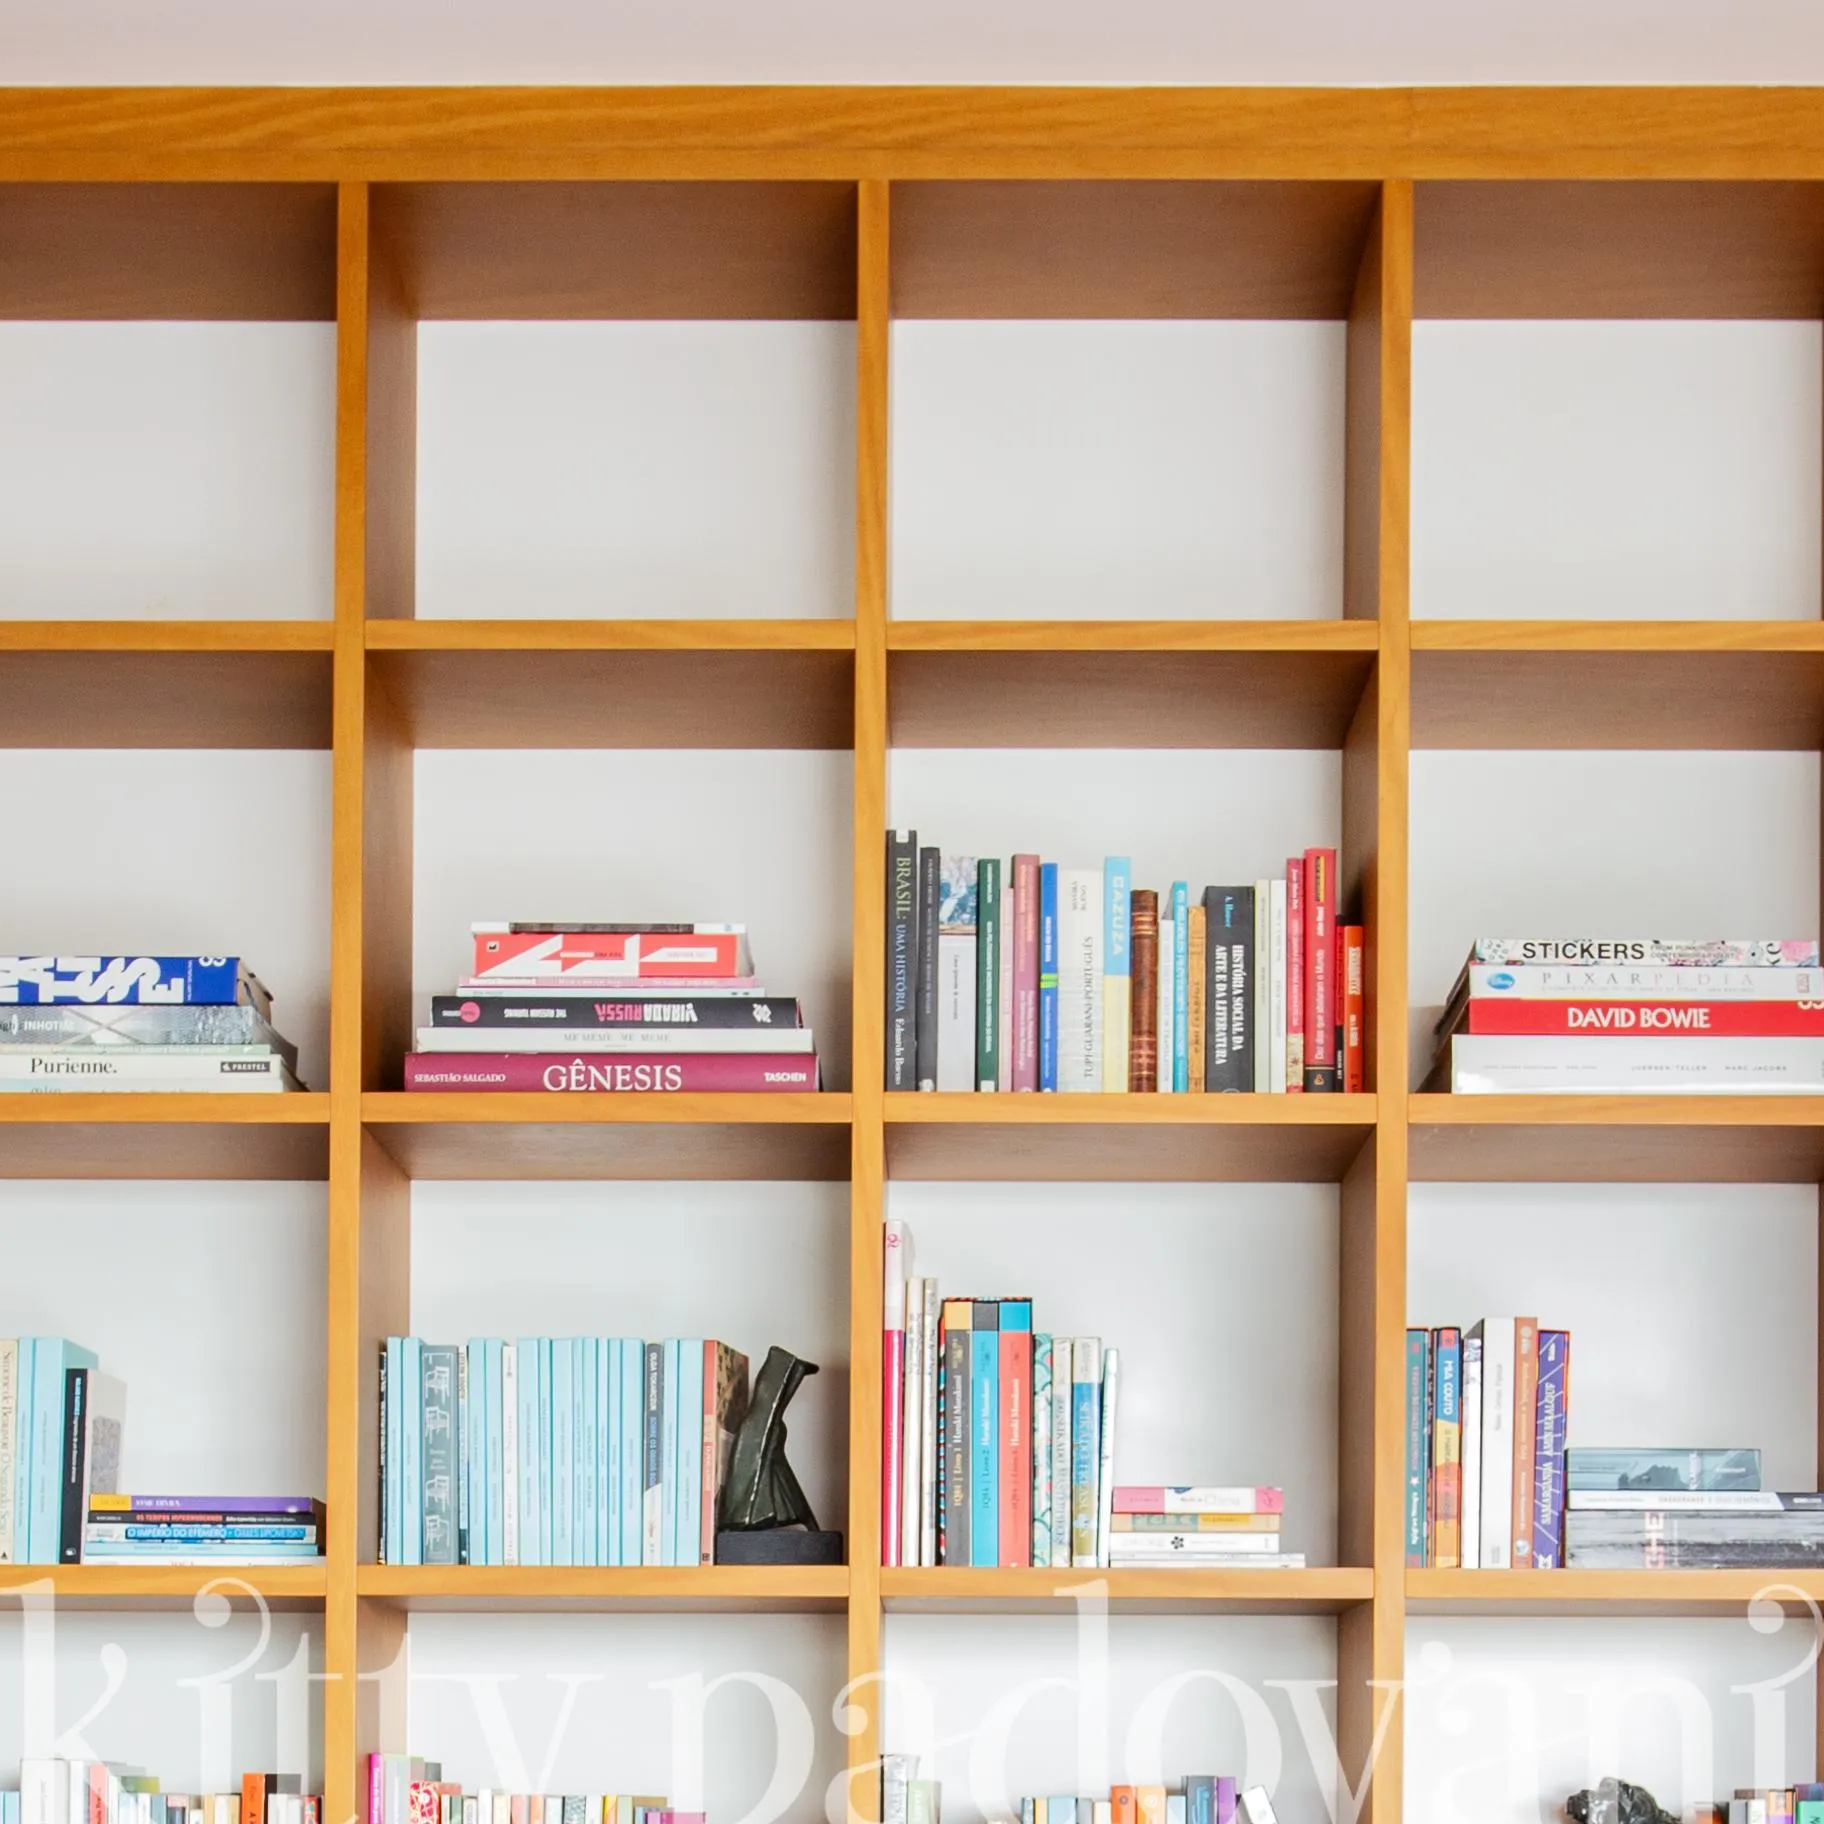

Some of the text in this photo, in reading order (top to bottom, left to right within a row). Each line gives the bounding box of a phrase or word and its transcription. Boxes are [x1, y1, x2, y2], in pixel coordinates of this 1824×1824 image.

[1111, 876, 1124, 955] CAZUZA
[894, 857, 912, 1012] BRASIL: UMA HISTÓRIA
[1215, 945, 1228, 973] ARTE
[1315, 950, 1325, 973] Mundo
[1522, 942, 1645, 960] STICKERS
[1215, 983, 1228, 997] DA
[1232, 945, 1246, 1051] HISTÓRIA SOCIAL DA
[1567, 1008, 1711, 1028] DAVID BOWIE
[893, 1018, 905, 1056] Eduardo
[1215, 999, 1228, 1065] LITERATURA
[31, 1058, 117, 1076] Purienne.
[414, 1072, 505, 1083] SEBASTIÃO SALGADO
[543, 1058, 682, 1092] GÊNESIS
[764, 1072, 806, 1082] TASCHEN
[649, 1352, 658, 1371] OLGA
[1443, 1360, 1454, 1415] MIA COUTO
[953, 1416, 963, 1443] Haruki
[1541, 1462, 1556, 1525] SAMARCANDA
